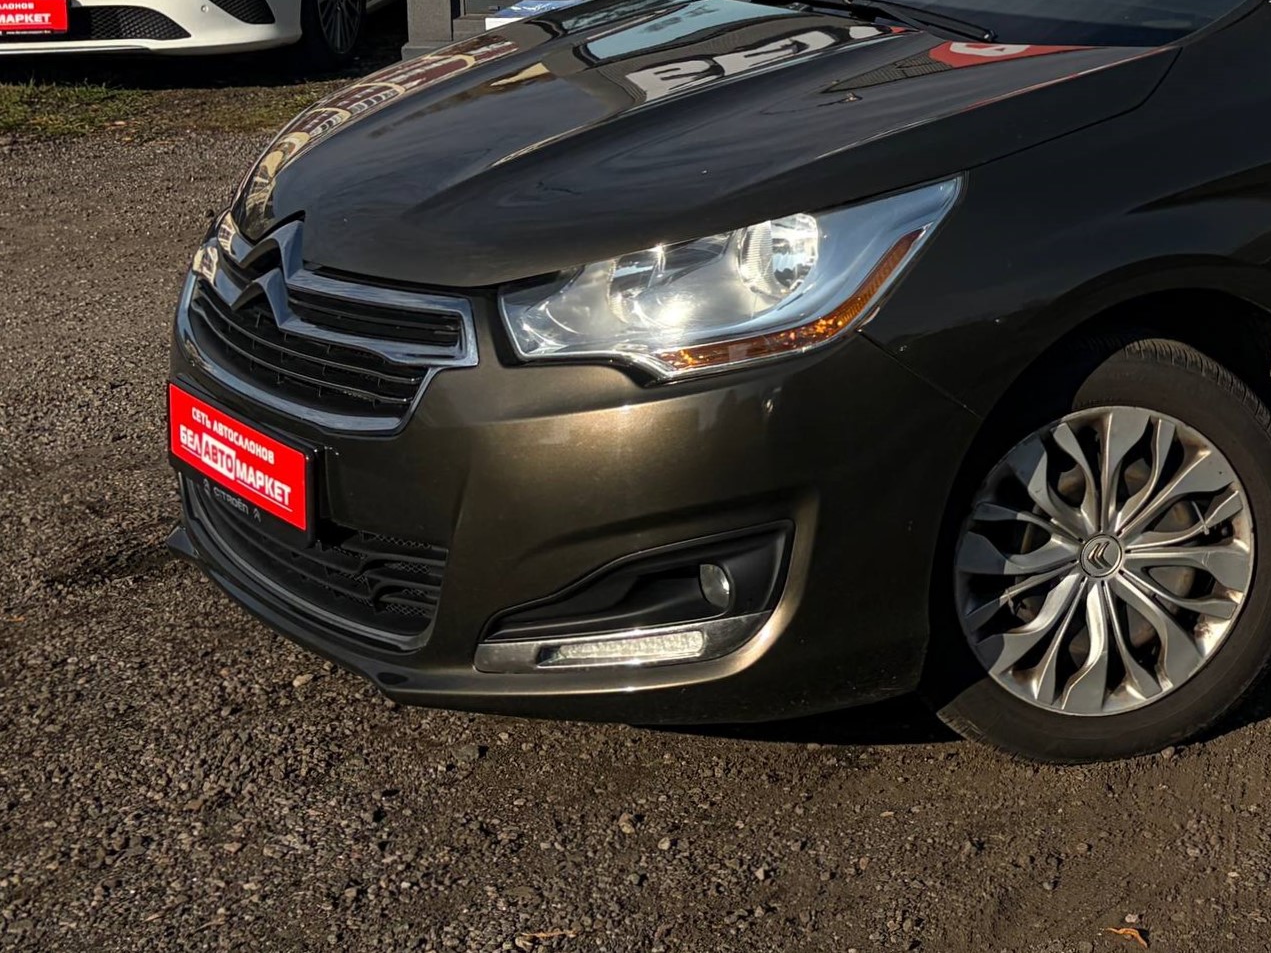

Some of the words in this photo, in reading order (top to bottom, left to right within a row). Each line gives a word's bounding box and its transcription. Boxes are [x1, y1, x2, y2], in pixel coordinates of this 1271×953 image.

[0, 2, 35, 10] ЛОНОВ
[191, 407, 212, 429] СЕТЬ
[212, 420, 275, 465] АВТОСАЛОНОВ
[179, 424, 202, 456] БЕЛ
[203, 440, 234, 474] АВТО
[235, 459, 292, 507] МАРКЕТ
